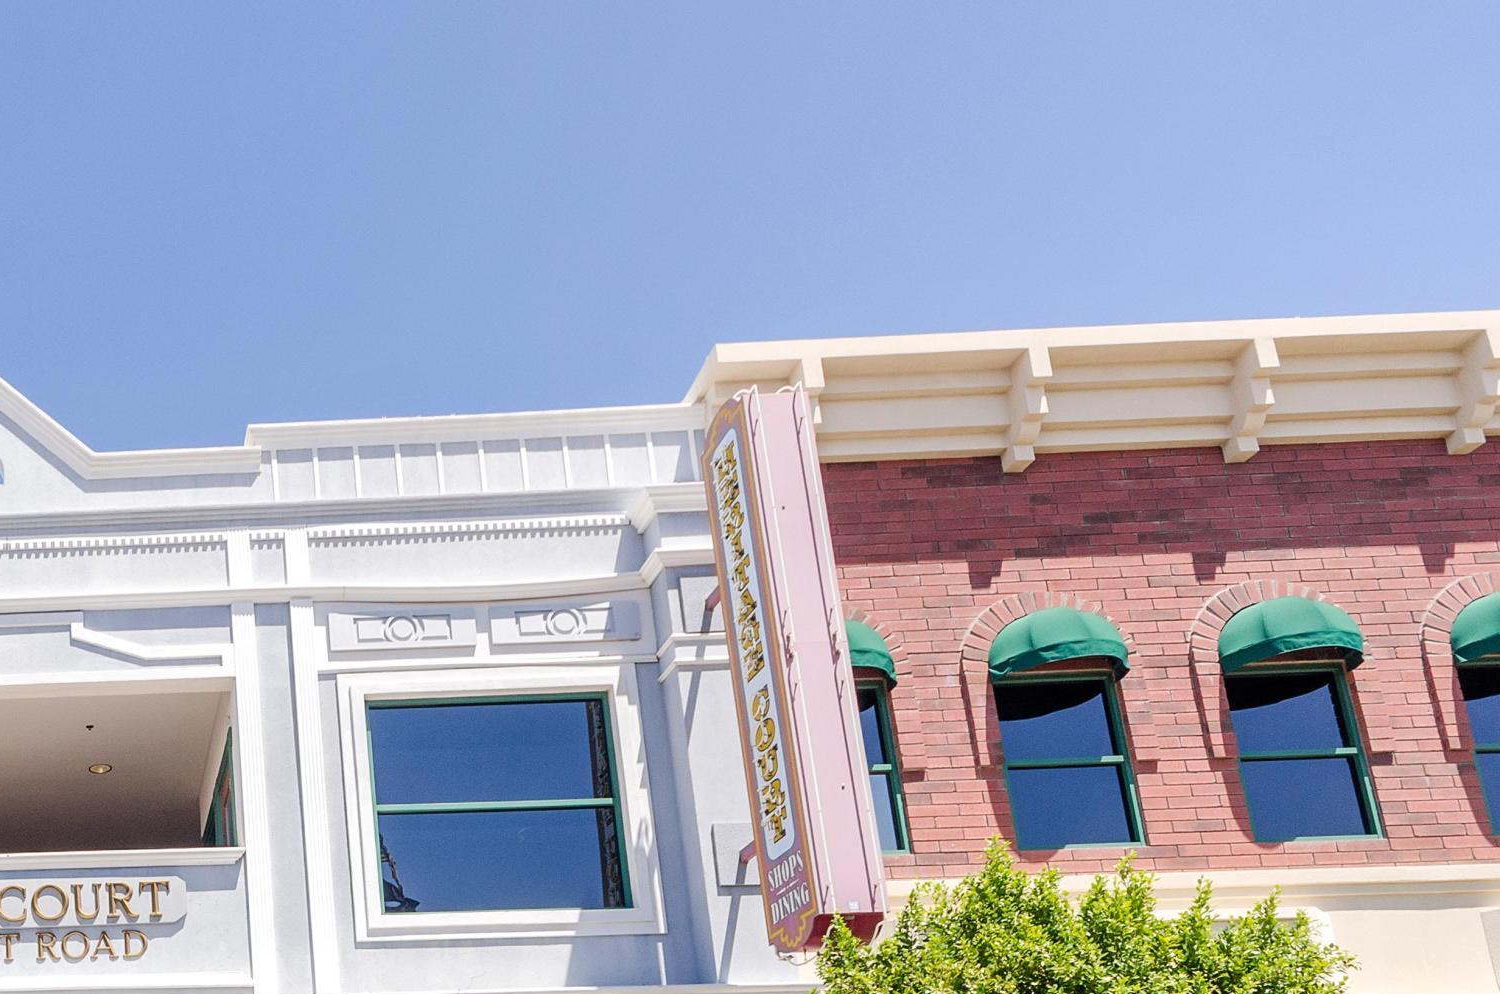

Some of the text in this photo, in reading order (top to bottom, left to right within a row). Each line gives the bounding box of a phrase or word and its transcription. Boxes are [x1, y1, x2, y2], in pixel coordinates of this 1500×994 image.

[751, 683, 789, 845] COURT
[767, 849, 805, 892] SHOPS
[770, 881, 811, 925] DINING
[35, 928, 150, 963] ROAD
